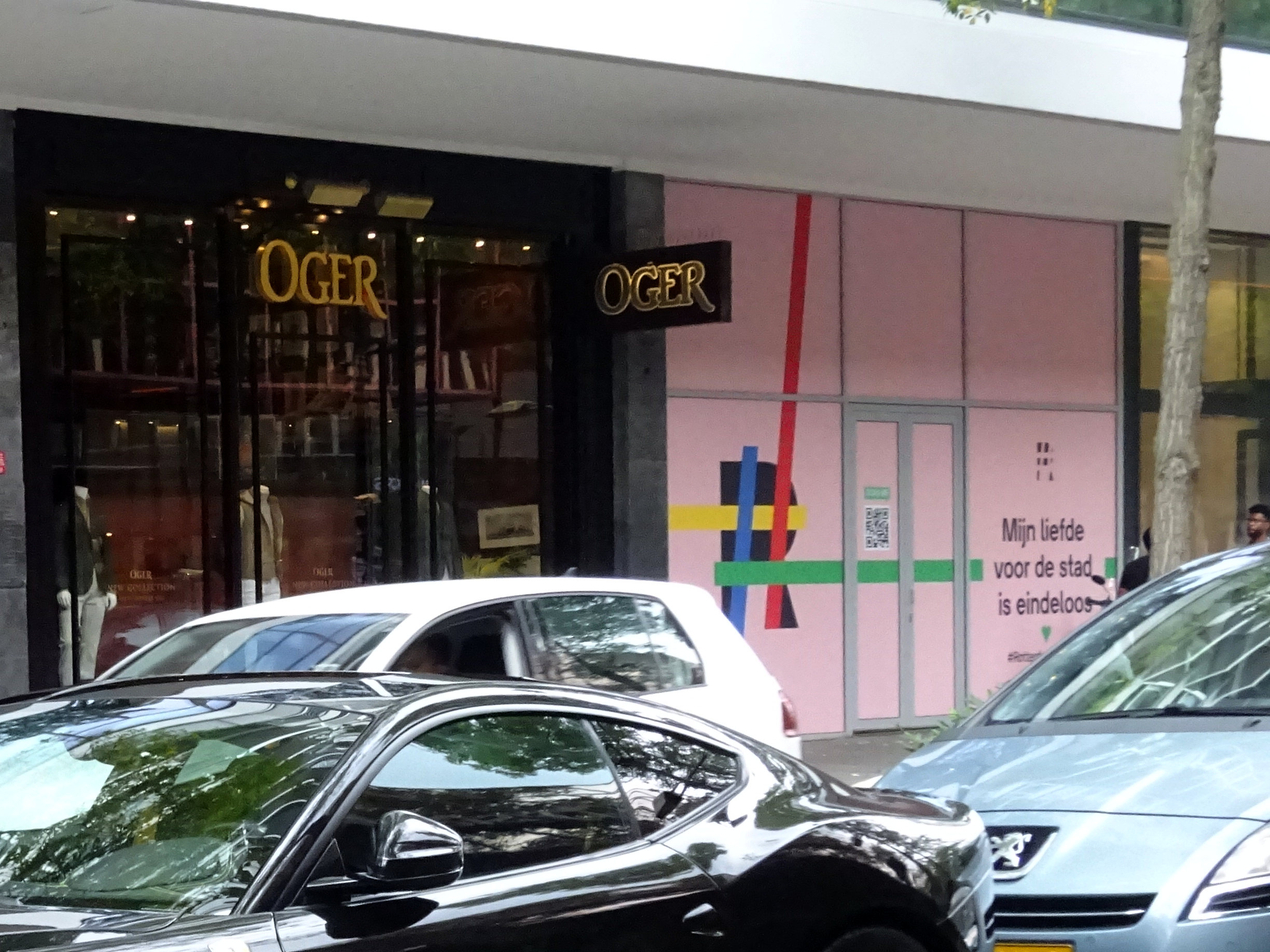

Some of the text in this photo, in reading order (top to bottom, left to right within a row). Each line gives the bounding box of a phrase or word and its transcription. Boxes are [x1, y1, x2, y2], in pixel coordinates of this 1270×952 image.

[259, 239, 388, 320] OGER
[594, 260, 716, 317] OGER
[1002, 517, 1085, 548] Mijn liefde
[994, 554, 1093, 579] voor de stad
[998, 590, 1093, 616] is eindeloos
